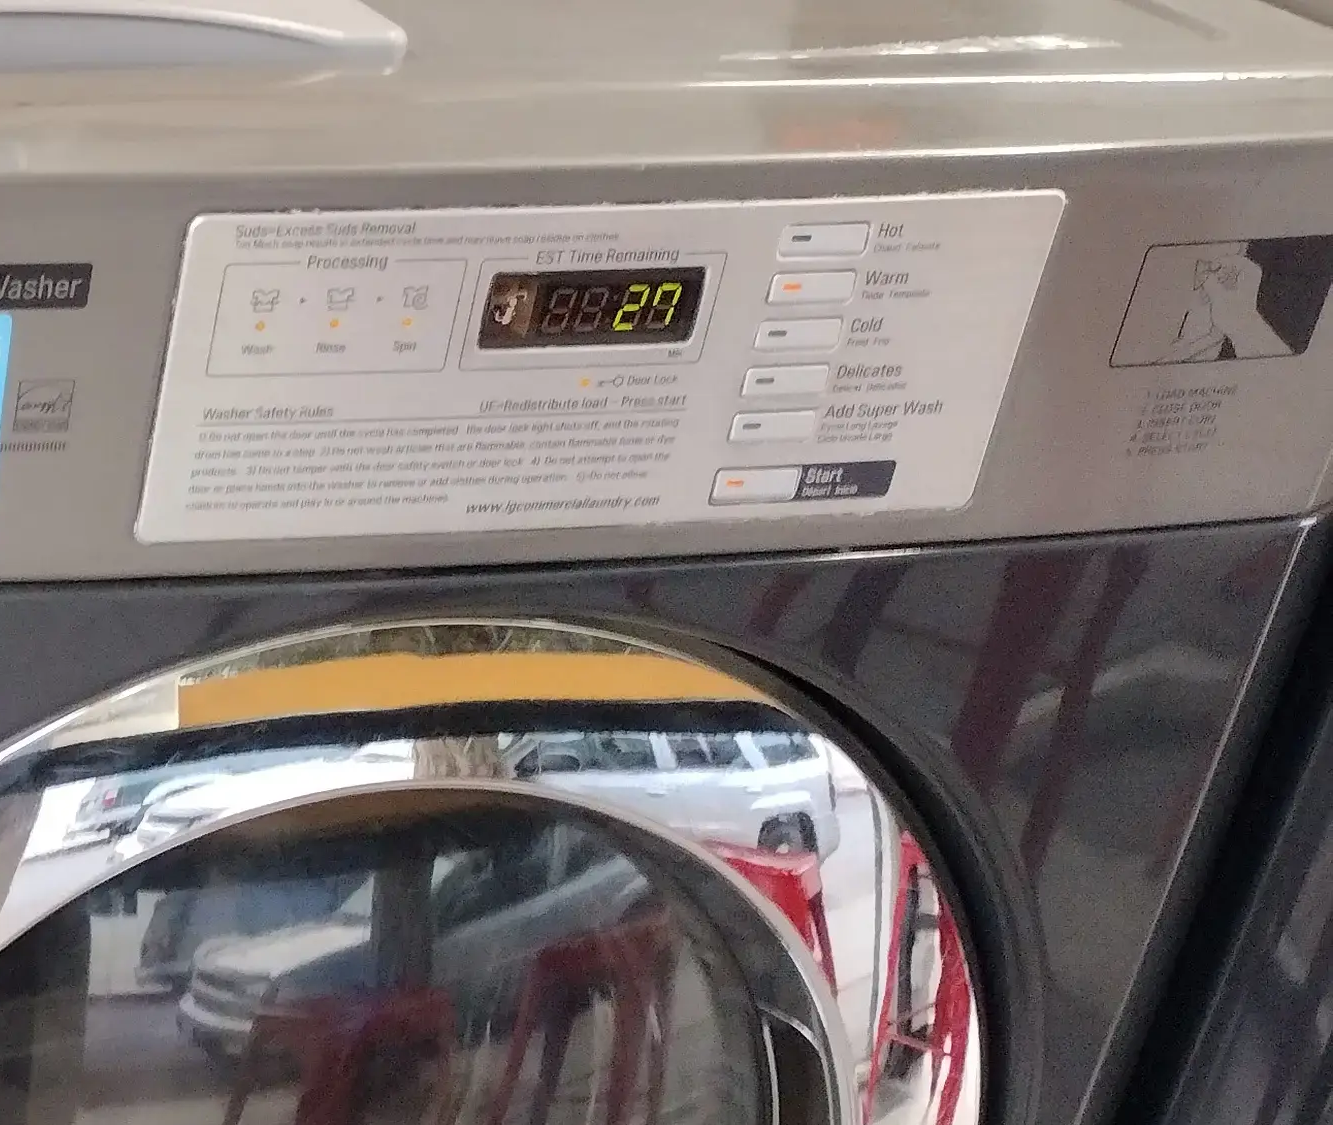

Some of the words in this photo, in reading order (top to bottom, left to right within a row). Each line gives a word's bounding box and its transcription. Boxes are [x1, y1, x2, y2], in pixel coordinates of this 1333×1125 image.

[361, 222, 416, 235] Removal
[877, 223, 904, 238] Hot
[307, 255, 389, 271] Processing
[536, 251, 565, 265] EST
[569, 250, 603, 263] Time
[606, 249, 680, 264] Remaining
[865, 271, 909, 286] Warm
[613, 283, 682, 331] 27
[851, 318, 884, 333] Cold
[654, 374, 678, 384] Lock
[837, 364, 903, 379] Delicates
[581, 398, 608, 410] load
[621, 396, 654, 408] Press
[657, 395, 687, 406] start
[824, 404, 855, 419] Add
[857, 403, 900, 419] Super
[903, 400, 944, 415] Wash
[203, 407, 251, 420] Washer
[255, 407, 296, 420] Safety
[299, 405, 334, 418] Rules
[806, 467, 843, 484] Start
